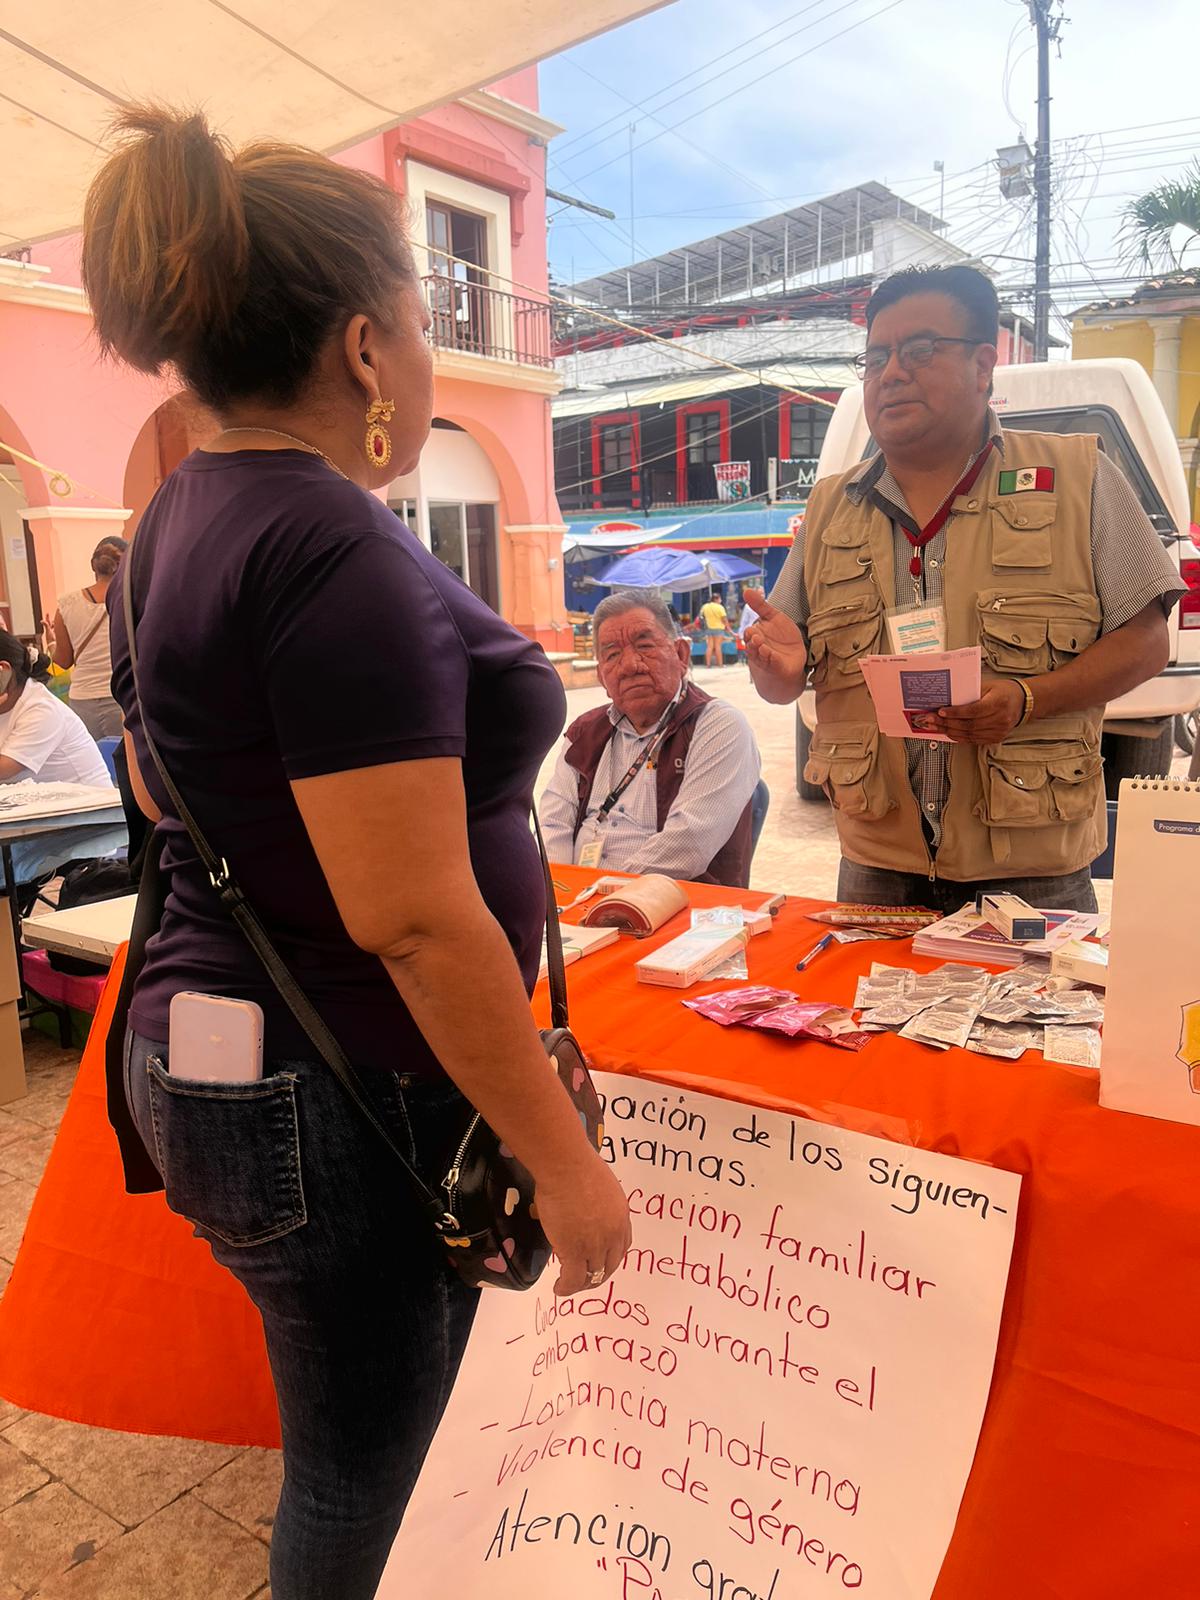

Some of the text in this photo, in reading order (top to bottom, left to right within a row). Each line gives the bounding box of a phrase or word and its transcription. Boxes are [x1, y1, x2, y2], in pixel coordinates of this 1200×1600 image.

[1158, 822, 1194, 833] Programa
[732, 1114, 771, 1149] de
[789, 1120, 843, 1172] los
[622, 1234, 830, 1330] metabólico
[760, 1204, 937, 1300] familiar
[532, 1330, 678, 1377] embarazo
[666, 1304, 820, 1386] durante
[835, 1365, 876, 1412] el
[507, 1366, 861, 1518] Lactancia materna
[497, 1427, 863, 1590] Violencia de género
